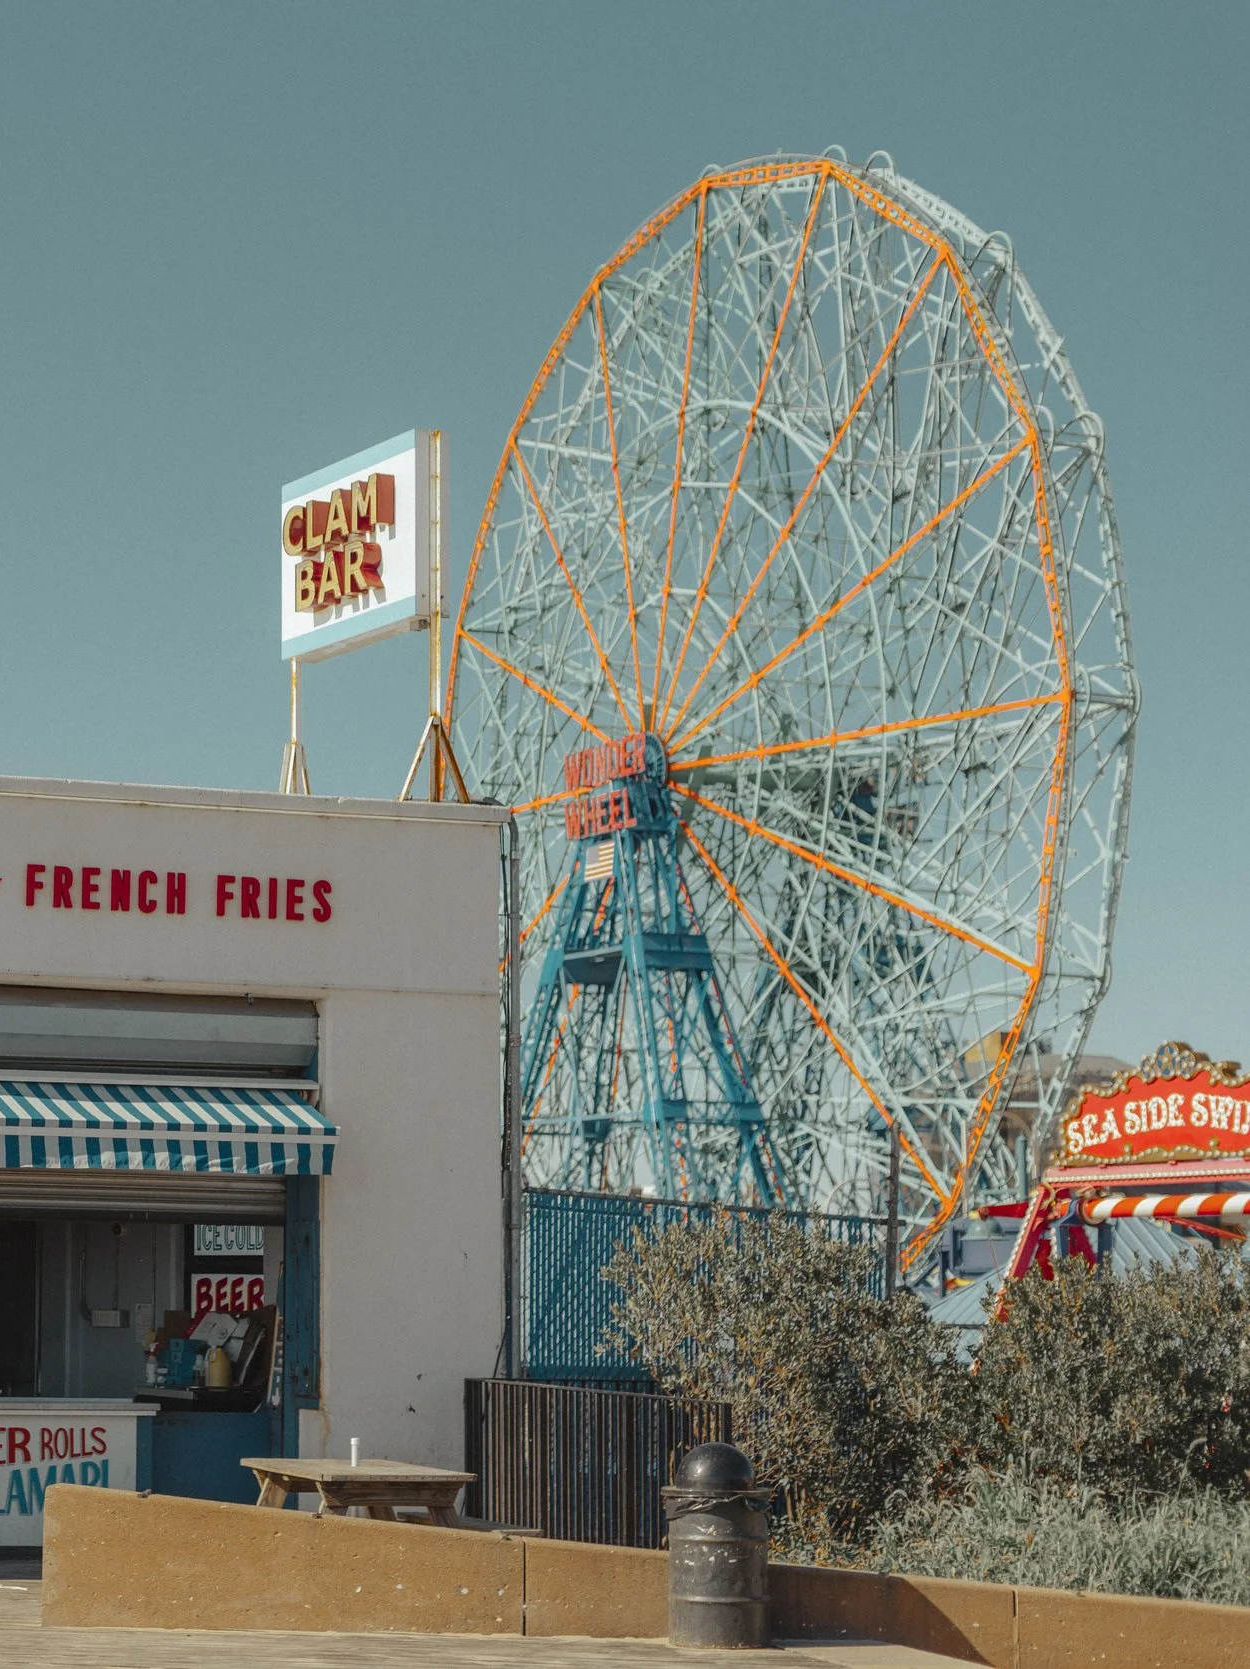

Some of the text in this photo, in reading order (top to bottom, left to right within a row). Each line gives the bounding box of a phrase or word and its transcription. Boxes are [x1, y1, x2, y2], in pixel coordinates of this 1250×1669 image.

[283, 473, 395, 556] CLAM
[295, 540, 385, 612] BAR
[564, 731, 646, 792] WONDER
[564, 787, 637, 840] WHEEL
[24, 863, 186, 915] FRENCH
[216, 874, 333, 923] FRIES
[1067, 1108, 1122, 1154] SEA
[1124, 1093, 1186, 1135] SIDE
[196, 1224, 223, 1250] ICE
[196, 1276, 264, 1313] BEER
[40, 1427, 107, 1461] ROLLS
